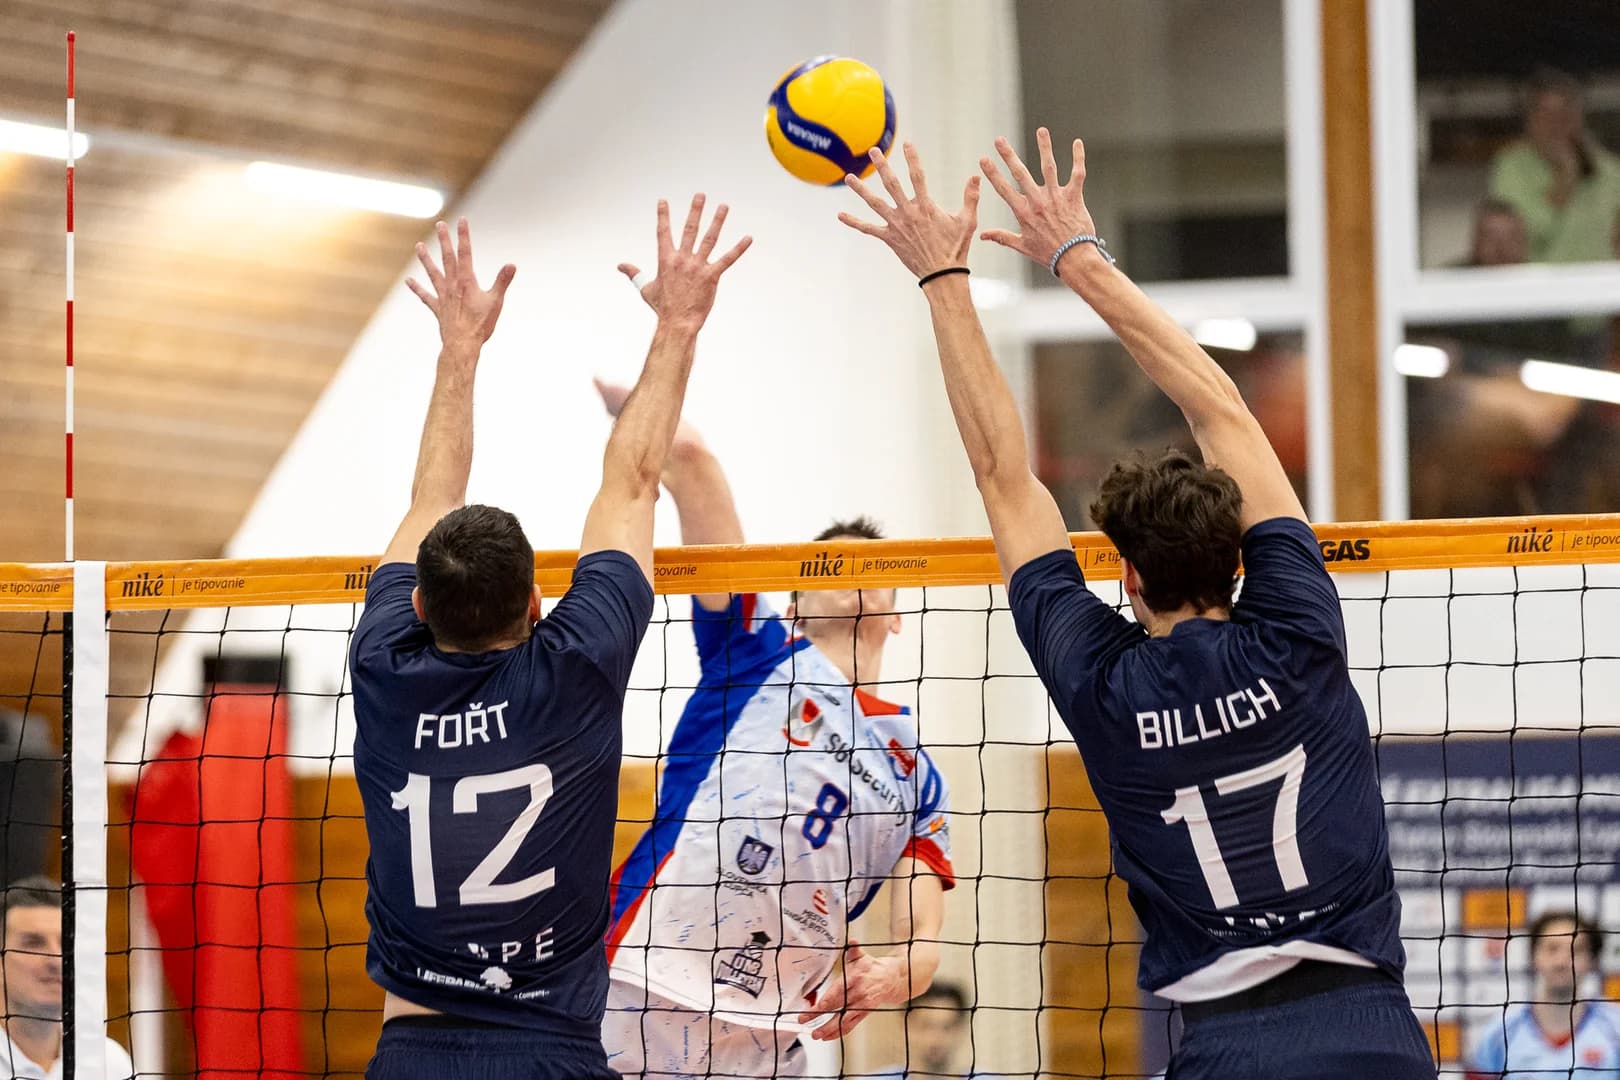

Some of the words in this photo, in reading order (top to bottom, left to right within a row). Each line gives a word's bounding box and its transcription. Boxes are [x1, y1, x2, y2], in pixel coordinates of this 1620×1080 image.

[1319, 539, 1370, 562] GAS
[1506, 526, 1553, 553] niké
[1571, 534, 1583, 549] je
[799, 551, 844, 577] niké
[860, 558, 873, 573] je
[874, 557, 928, 572] tipovanie
[1094, 550, 1106, 566] je
[10, 582, 61, 596] tipovanie
[121, 572, 164, 598] niké
[180, 578, 192, 593] je
[194, 578, 245, 592] tipovanie
[414, 700, 510, 750] FOŘT
[1136, 677, 1282, 750] BILLICH
[801, 781, 849, 850] 8
[1160, 743, 1310, 910] 17
[390, 763, 556, 909] 12
